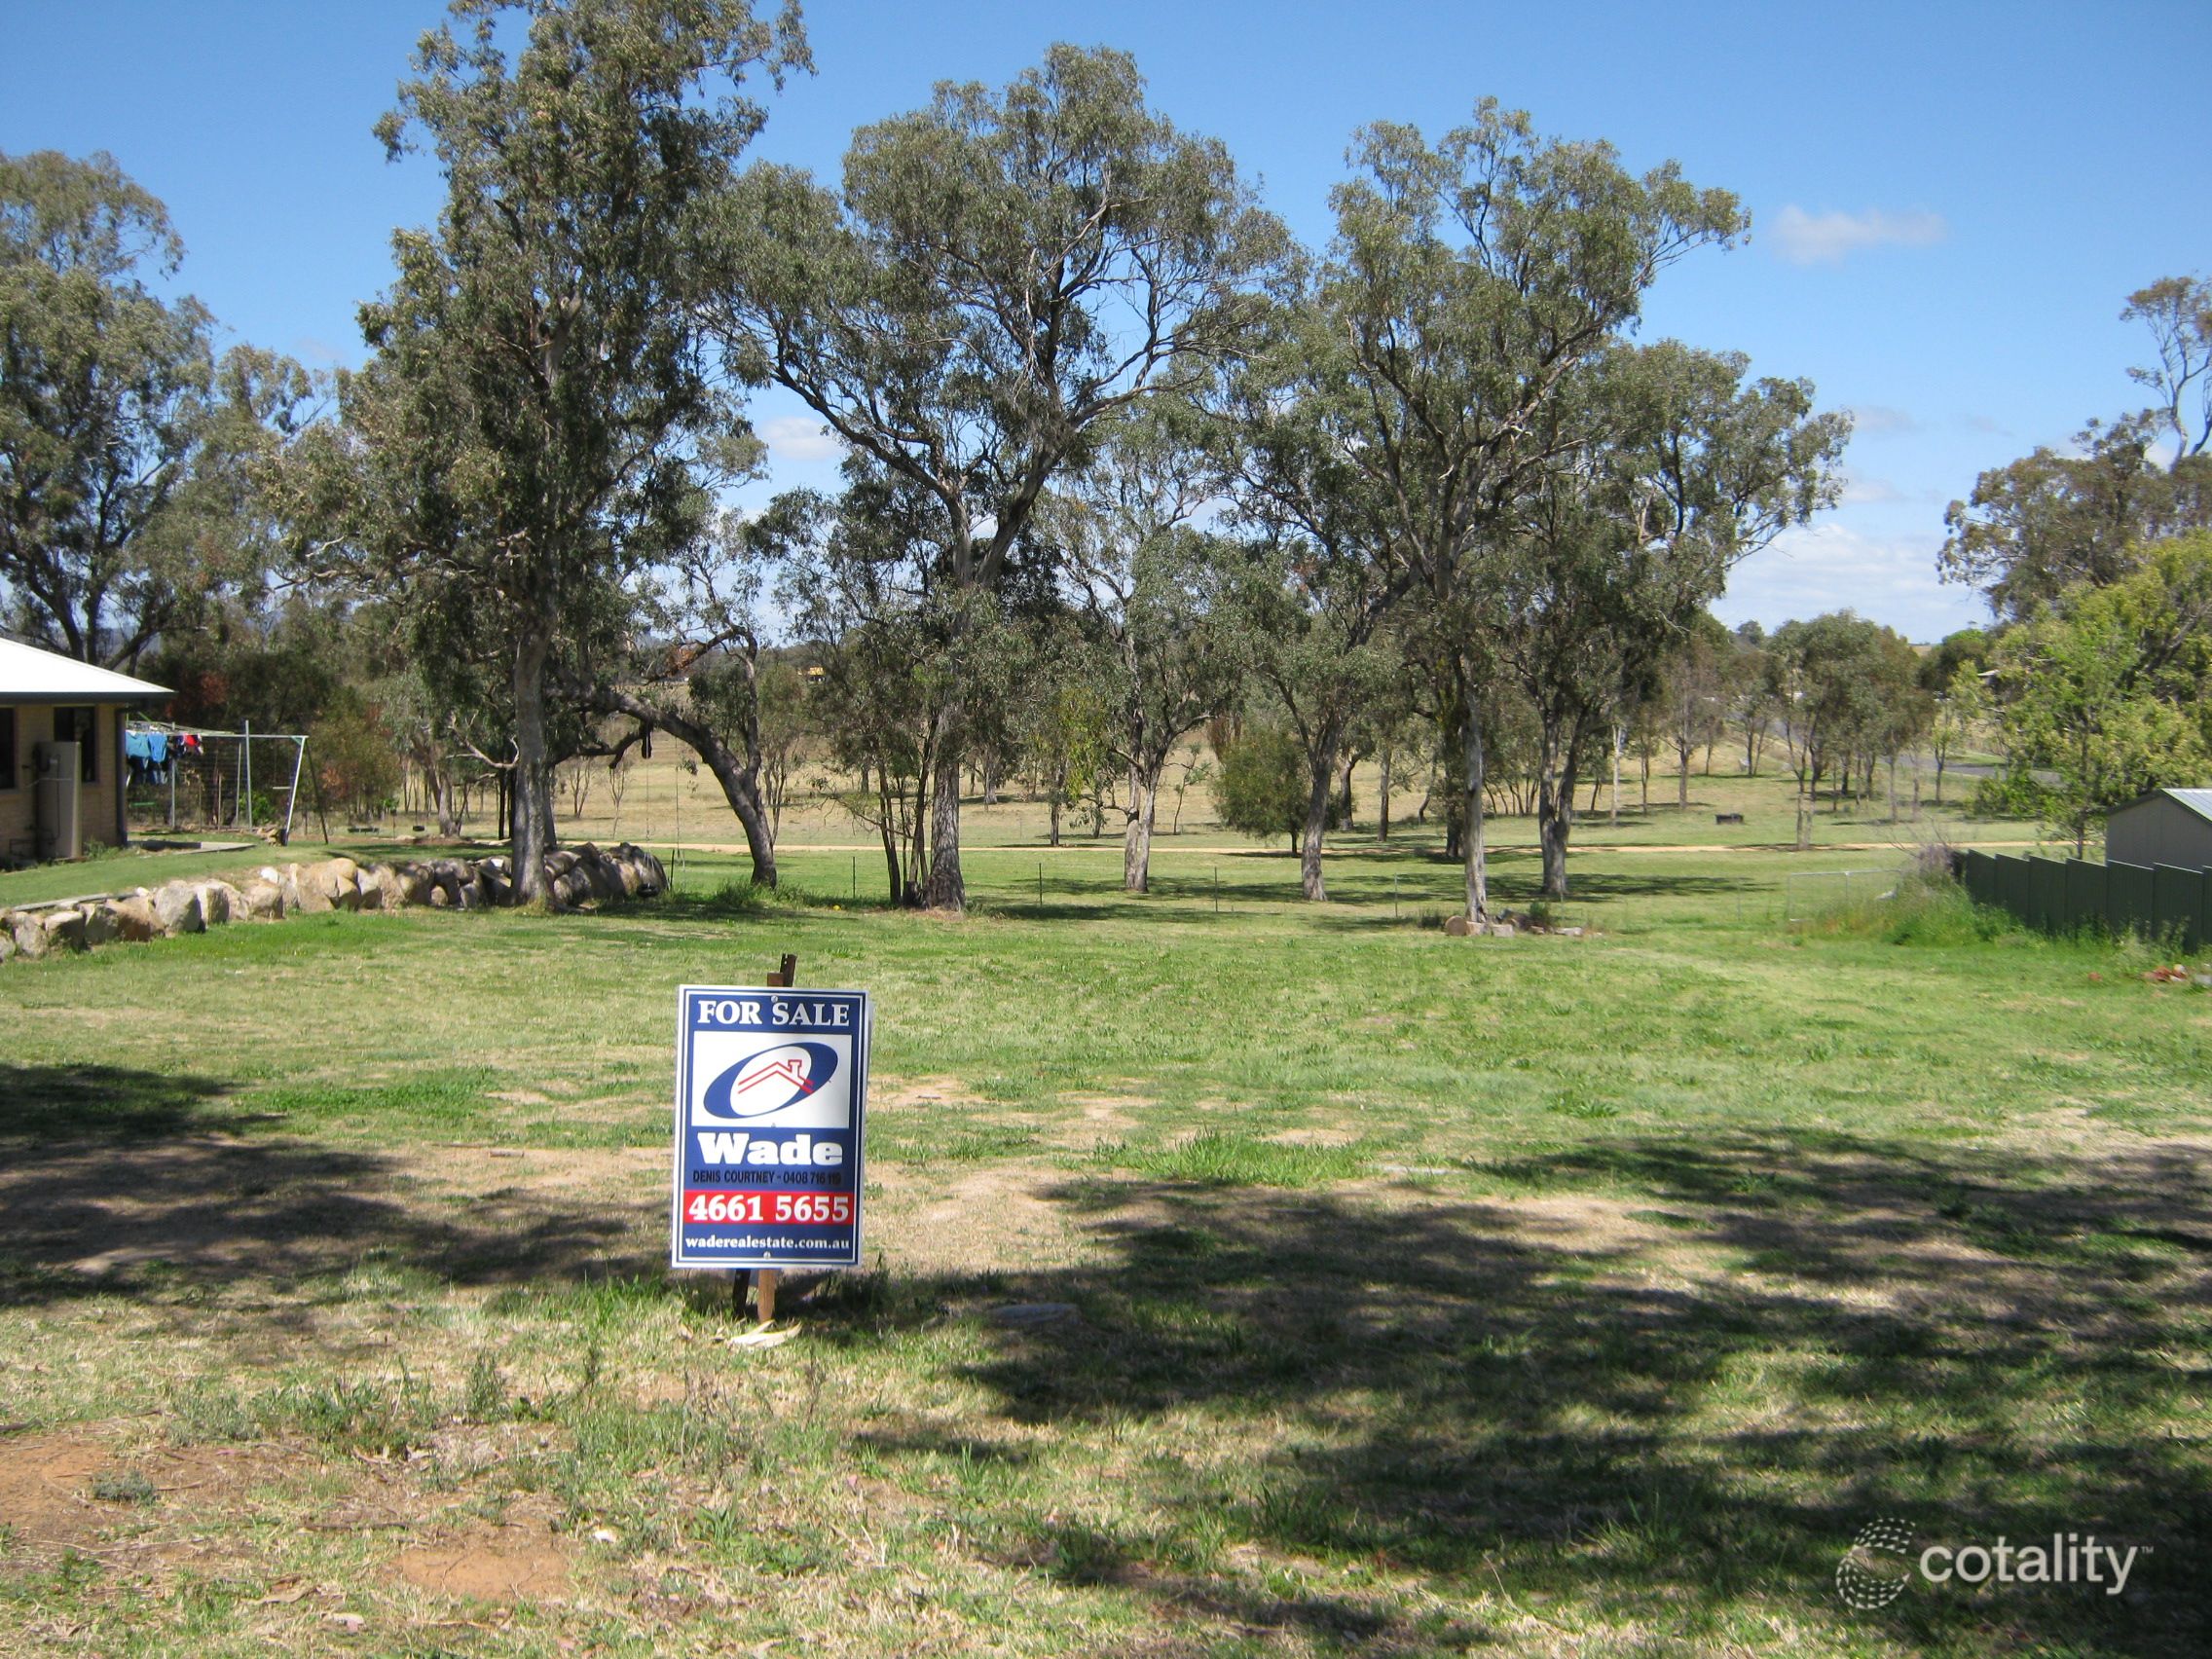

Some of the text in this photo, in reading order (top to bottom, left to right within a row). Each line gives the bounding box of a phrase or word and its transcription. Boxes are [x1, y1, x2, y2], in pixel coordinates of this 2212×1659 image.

[697, 1000, 850, 1027] FOR SALE
[697, 1132, 843, 1165] Wade
[692, 1170, 721, 1183] DENIS
[724, 1170, 776, 1184] COURTNEY
[783, 1171, 808, 1184] 0408
[688, 1194, 849, 1222] 4661 5655
[685, 1235, 850, 1249] waderealestate.com.au
